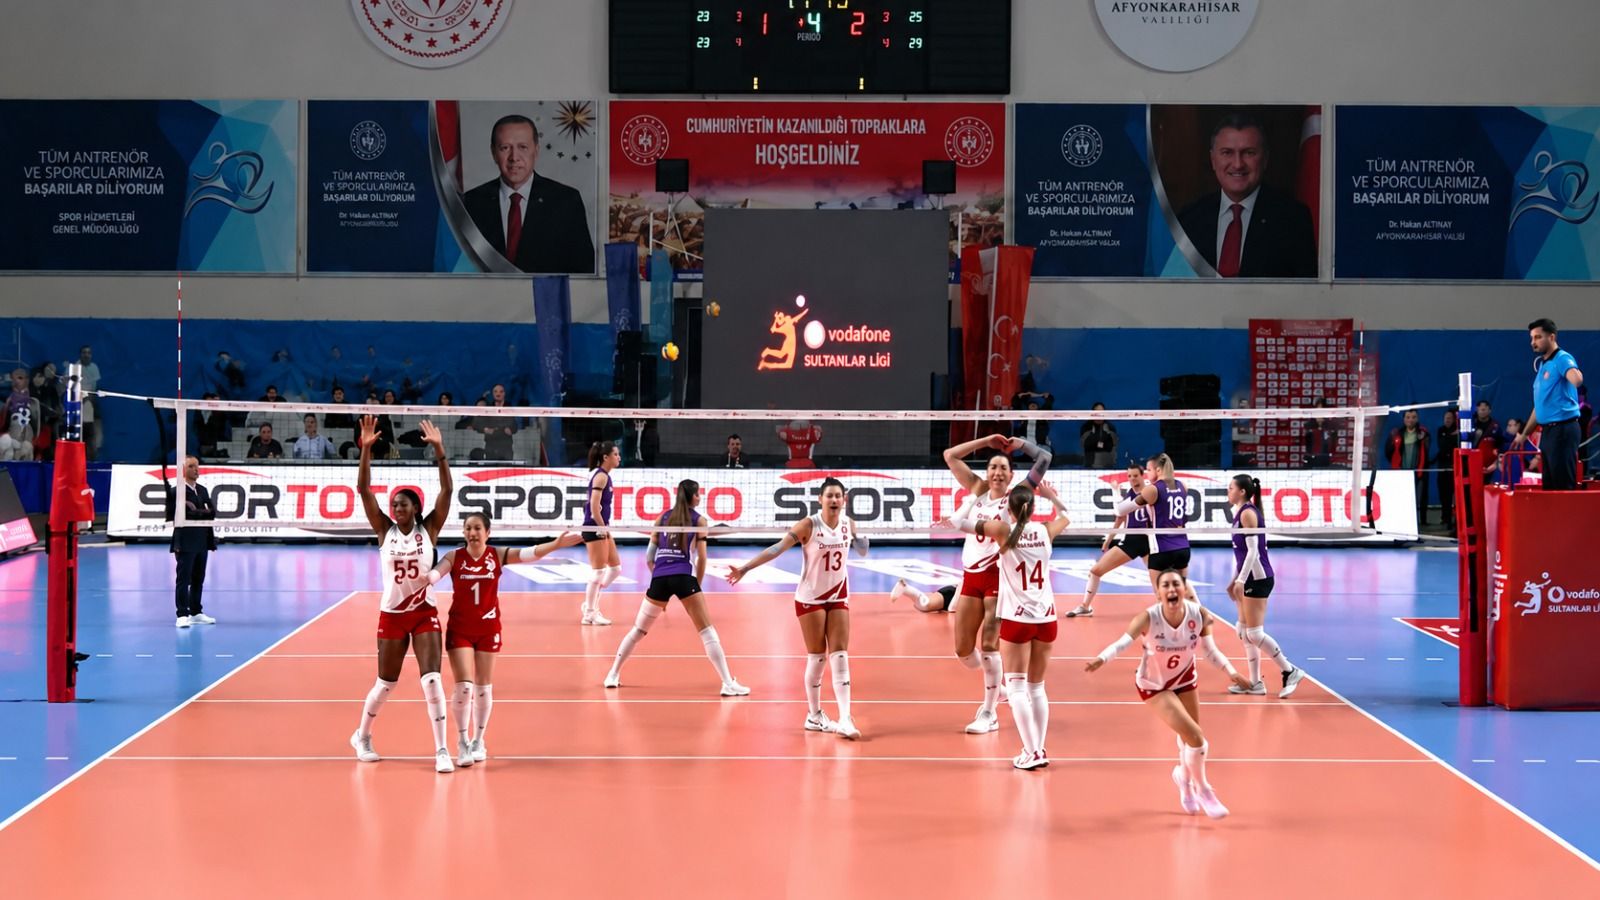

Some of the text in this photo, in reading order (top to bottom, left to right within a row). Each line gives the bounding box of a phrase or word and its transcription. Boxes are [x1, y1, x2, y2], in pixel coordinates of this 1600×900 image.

[697, 11, 709, 22] 23
[808, 13, 820, 33] 4
[851, 12, 864, 35] 2
[909, 12, 922, 22] 25
[697, 37, 710, 48] 23
[909, 38, 922, 48] 29
[686, 115, 926, 134] CUMHURİYETİN KAZANILDIĞI TOPRAKLARA
[39, 149, 148, 163] TÜM ANTRENÖR
[756, 140, 859, 169] HOŞGELDİNİZ
[1366, 156, 1474, 172] TÜM ANTRENÖR
[24, 166, 164, 179] VE SPORCULARIMIZA
[25, 181, 164, 197] BAŞARILAR DİLİYORUM
[323, 182, 334, 191] VE
[1038, 180, 1123, 191] TÜM ANTRENÖR
[1352, 176, 1489, 188] VE SPORCULARIMIZA
[1026, 193, 1135, 203] VE SPORCULARIMIZA
[1353, 191, 1489, 206] BAŞARILAR DİLİYORUM
[59, 213, 82, 221] SPOR
[1028, 206, 1079, 217] BAŞARILAR
[53, 225, 80, 233] GENEL
[828, 325, 890, 342] vodafone
[804, 353, 890, 367] SULTANLAR LİGİ
[1167, 495, 1184, 520] 18
[822, 550, 842, 572] 13
[394, 559, 419, 585] 55
[1015, 560, 1044, 591] 14
[470, 582, 480, 605] 1
[1566, 589, 1600, 599] vodafo
[1548, 604, 1591, 613] SULTANLAR
[1167, 654, 1181, 670] 6
